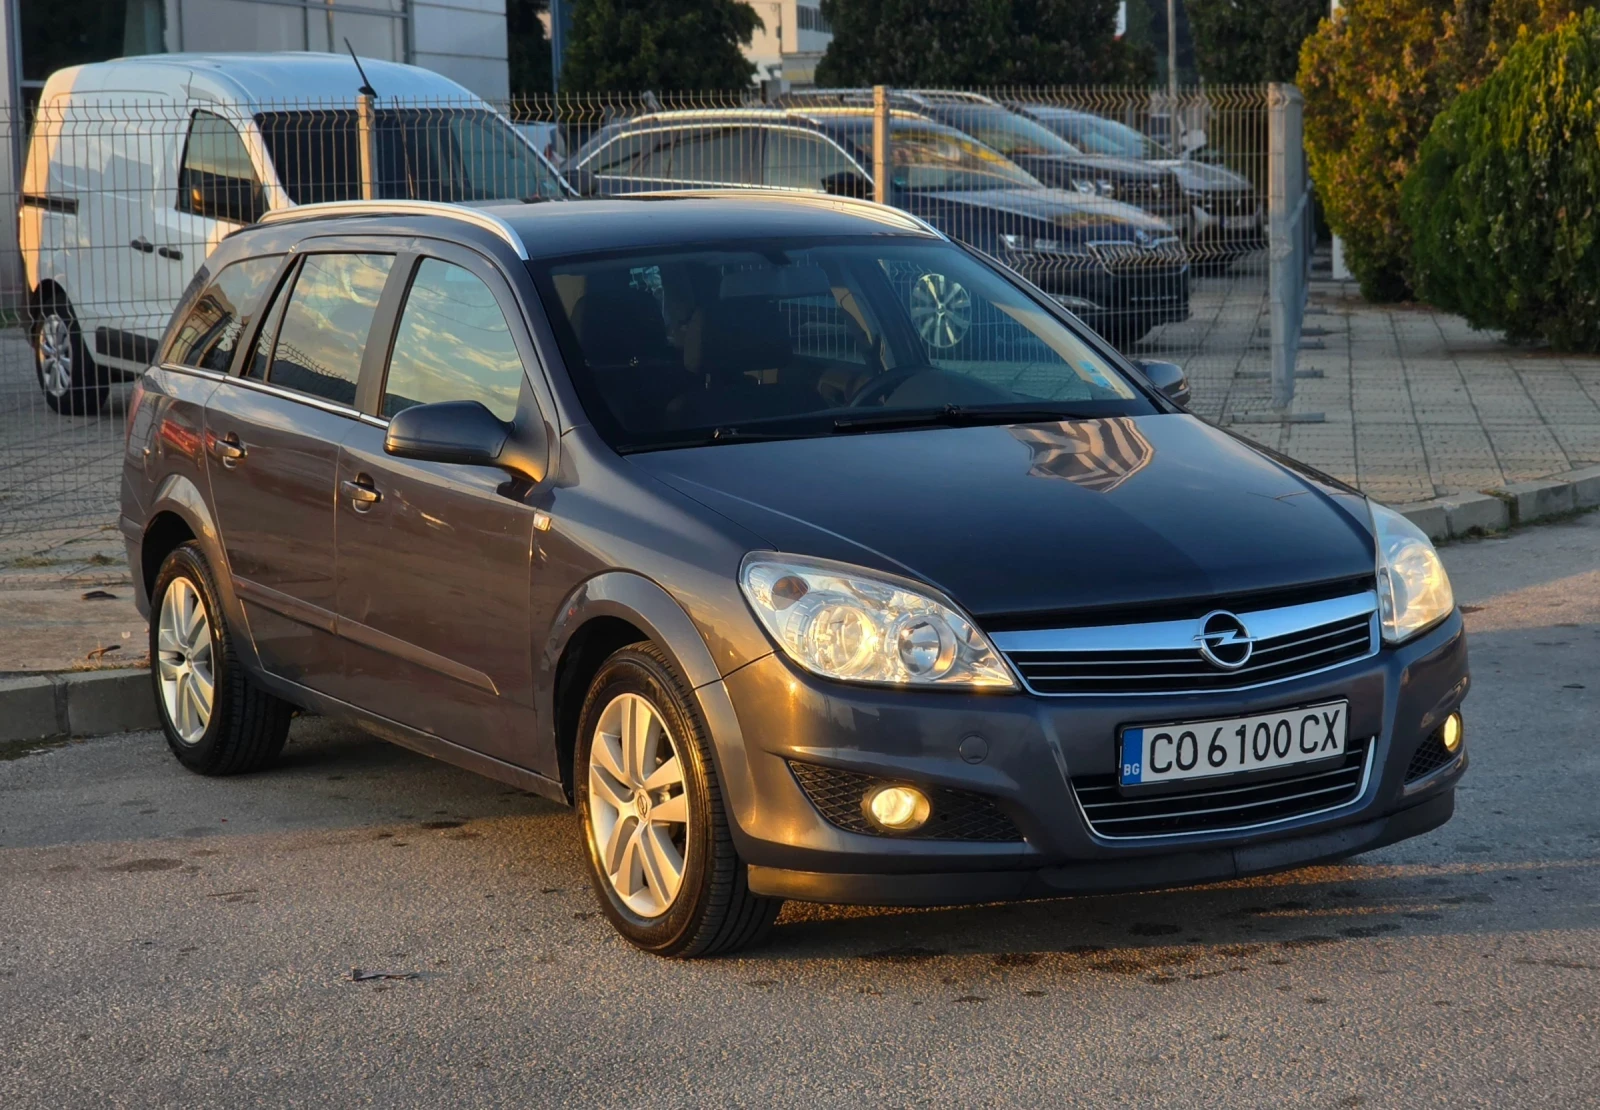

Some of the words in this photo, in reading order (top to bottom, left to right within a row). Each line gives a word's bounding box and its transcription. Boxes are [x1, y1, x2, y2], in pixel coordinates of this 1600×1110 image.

[1150, 731, 1199, 774] CO
[1207, 719, 1292, 767] 6100
[1299, 709, 1340, 754] CX
[1123, 762, 1140, 776] BG
